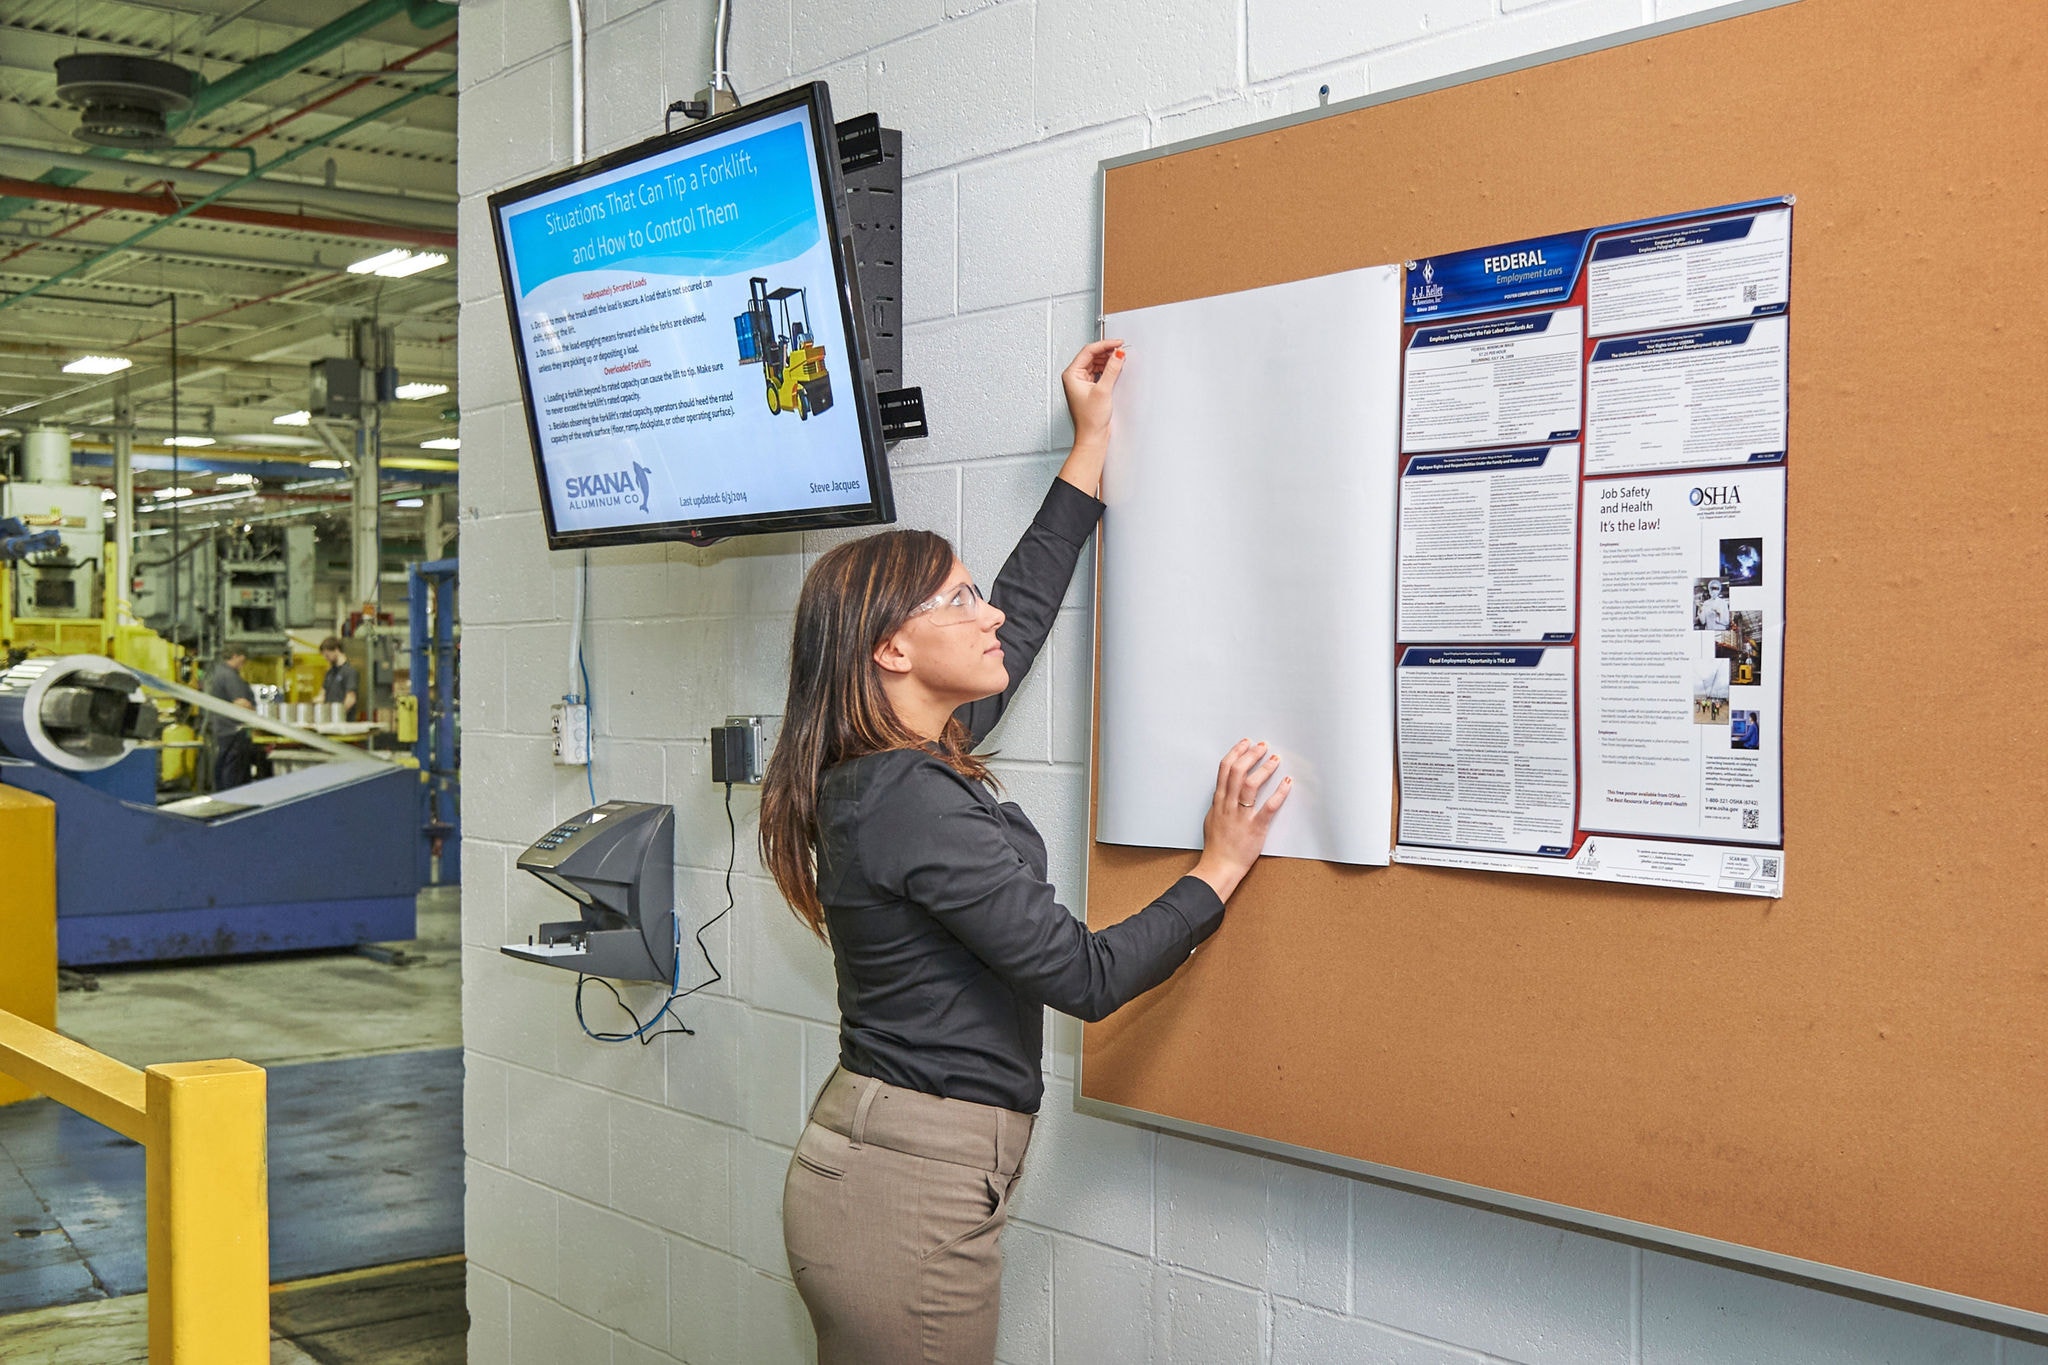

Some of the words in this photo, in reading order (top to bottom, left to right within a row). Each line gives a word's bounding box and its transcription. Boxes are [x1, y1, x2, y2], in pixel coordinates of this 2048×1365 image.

[545, 202, 606, 235] Situations
[606, 191, 637, 215] That
[638, 184, 664, 206] Can
[664, 174, 686, 201] Tip
[690, 175, 698, 191] a
[700, 149, 758, 187] Forklift,
[572, 242, 596, 265] and
[597, 236, 627, 256] How
[628, 229, 644, 249] to
[645, 208, 697, 244] Control
[697, 201, 739, 231] Them
[1484, 249, 1546, 274] FEDERAL
[1496, 270, 1542, 285] Employment
[1543, 267, 1563, 277] Laws
[583, 286, 613, 301] Inadequately
[612, 281, 632, 294] Secured
[632, 277, 647, 289] Loads
[1426, 284, 1444, 297] Keller
[555, 316, 567, 324] move
[567, 312, 575, 321] the
[575, 310, 588, 320] truck
[588, 306, 598, 316] until
[599, 303, 607, 312] the
[607, 299, 617, 310] load
[617, 299, 622, 309] is
[623, 298, 640, 308] secure.
[640, 295, 645, 303] A
[645, 291, 656, 301] load
[656, 288, 667, 299] that
[667, 288, 673, 297] is
[673, 286, 681, 296] not
[681, 279, 702, 293] secured
[703, 279, 713, 289] can
[540, 347, 547, 355] Do
[562, 343, 570, 352] the
[602, 335, 616, 345] means
[617, 328, 636, 339] forward
[637, 325, 650, 336] while
[650, 322, 659, 332] the
[659, 320, 673, 330] forks
[673, 319, 682, 328] are
[683, 312, 706, 325] elevated,
[1429, 335, 1450, 343] Employee
[1450, 333, 1463, 341] Rights
[1463, 331, 1476, 339] Under
[1483, 329, 1491, 337] Fair
[1504, 325, 1525, 334] Standards
[538, 363, 552, 373] unless
[552, 361, 562, 371] they
[570, 357, 586, 367] picking
[587, 354, 593, 364] up
[599, 349, 623, 360] depositing
[627, 344, 639, 354] load.
[604, 361, 631, 375] Overloaded
[631, 359, 652, 371] Forklifts
[547, 392, 565, 403] Loading
[568, 387, 584, 398] forklift
[584, 385, 601, 396] beyond
[607, 380, 620, 391] rated
[620, 378, 640, 390] capacity
[640, 377, 649, 386] can
[649, 374, 663, 383] cause
[663, 371, 673, 380] the
[673, 369, 681, 379] lift
[681, 369, 687, 378] to
[687, 367, 696, 378] tip.
[696, 363, 711, 375] Make
[712, 363, 723, 372] sure
[546, 407, 551, 416] to
[551, 405, 563, 415] never
[564, 403, 579, 412] exceed
[579, 401, 587, 410] the
[607, 395, 620, 405] rated
[620, 392, 640, 404] capacity.
[552, 420, 569, 430] Besides
[569, 418, 591, 427] observing
[591, 415, 599, 424] the
[619, 408, 632, 418] rated
[632, 406, 653, 418] capacity,
[653, 403, 678, 414] operators
[678, 398, 695, 410] should
[695, 395, 708, 406] heed
[709, 394, 718, 403] the
[718, 391, 734, 403] rated
[550, 433, 568, 444] capacity
[568, 431, 574, 441] of
[574, 431, 582, 440] the
[582, 428, 593, 438] work
[594, 426, 610, 437] surface
[611, 424, 625, 436] (floor,
[625, 422, 640, 432] ramp,
[640, 418, 665, 430] dockplate,
[665, 418, 671, 426] or
[671, 414, 685, 424] other
[686, 410, 712, 422] operating
[712, 405, 735, 418] surface).
[565, 470, 635, 499] SKANA
[809, 481, 830, 494] Steve
[831, 479, 860, 493] Jacques
[1601, 488, 1618, 500] Job
[1620, 486, 1650, 499] Safety
[1689, 485, 1742, 506] OSHA
[569, 495, 621, 510] ALUMINUM
[624, 494, 639, 504] CO
[680, 496, 695, 507] Last
[696, 493, 720, 507] updated:
[721, 491, 748, 505] 6/3/2014
[1600, 502, 1618, 514] and
[1621, 500, 1653, 513] Health
[1600, 520, 1615, 533] It's
[1618, 519, 1635, 532] the
[1638, 517, 1661, 531] law!
[1429, 657, 1441, 665] Equal
[1441, 657, 1466, 666] Employment
[1466, 657, 1493, 665] Opportunity
